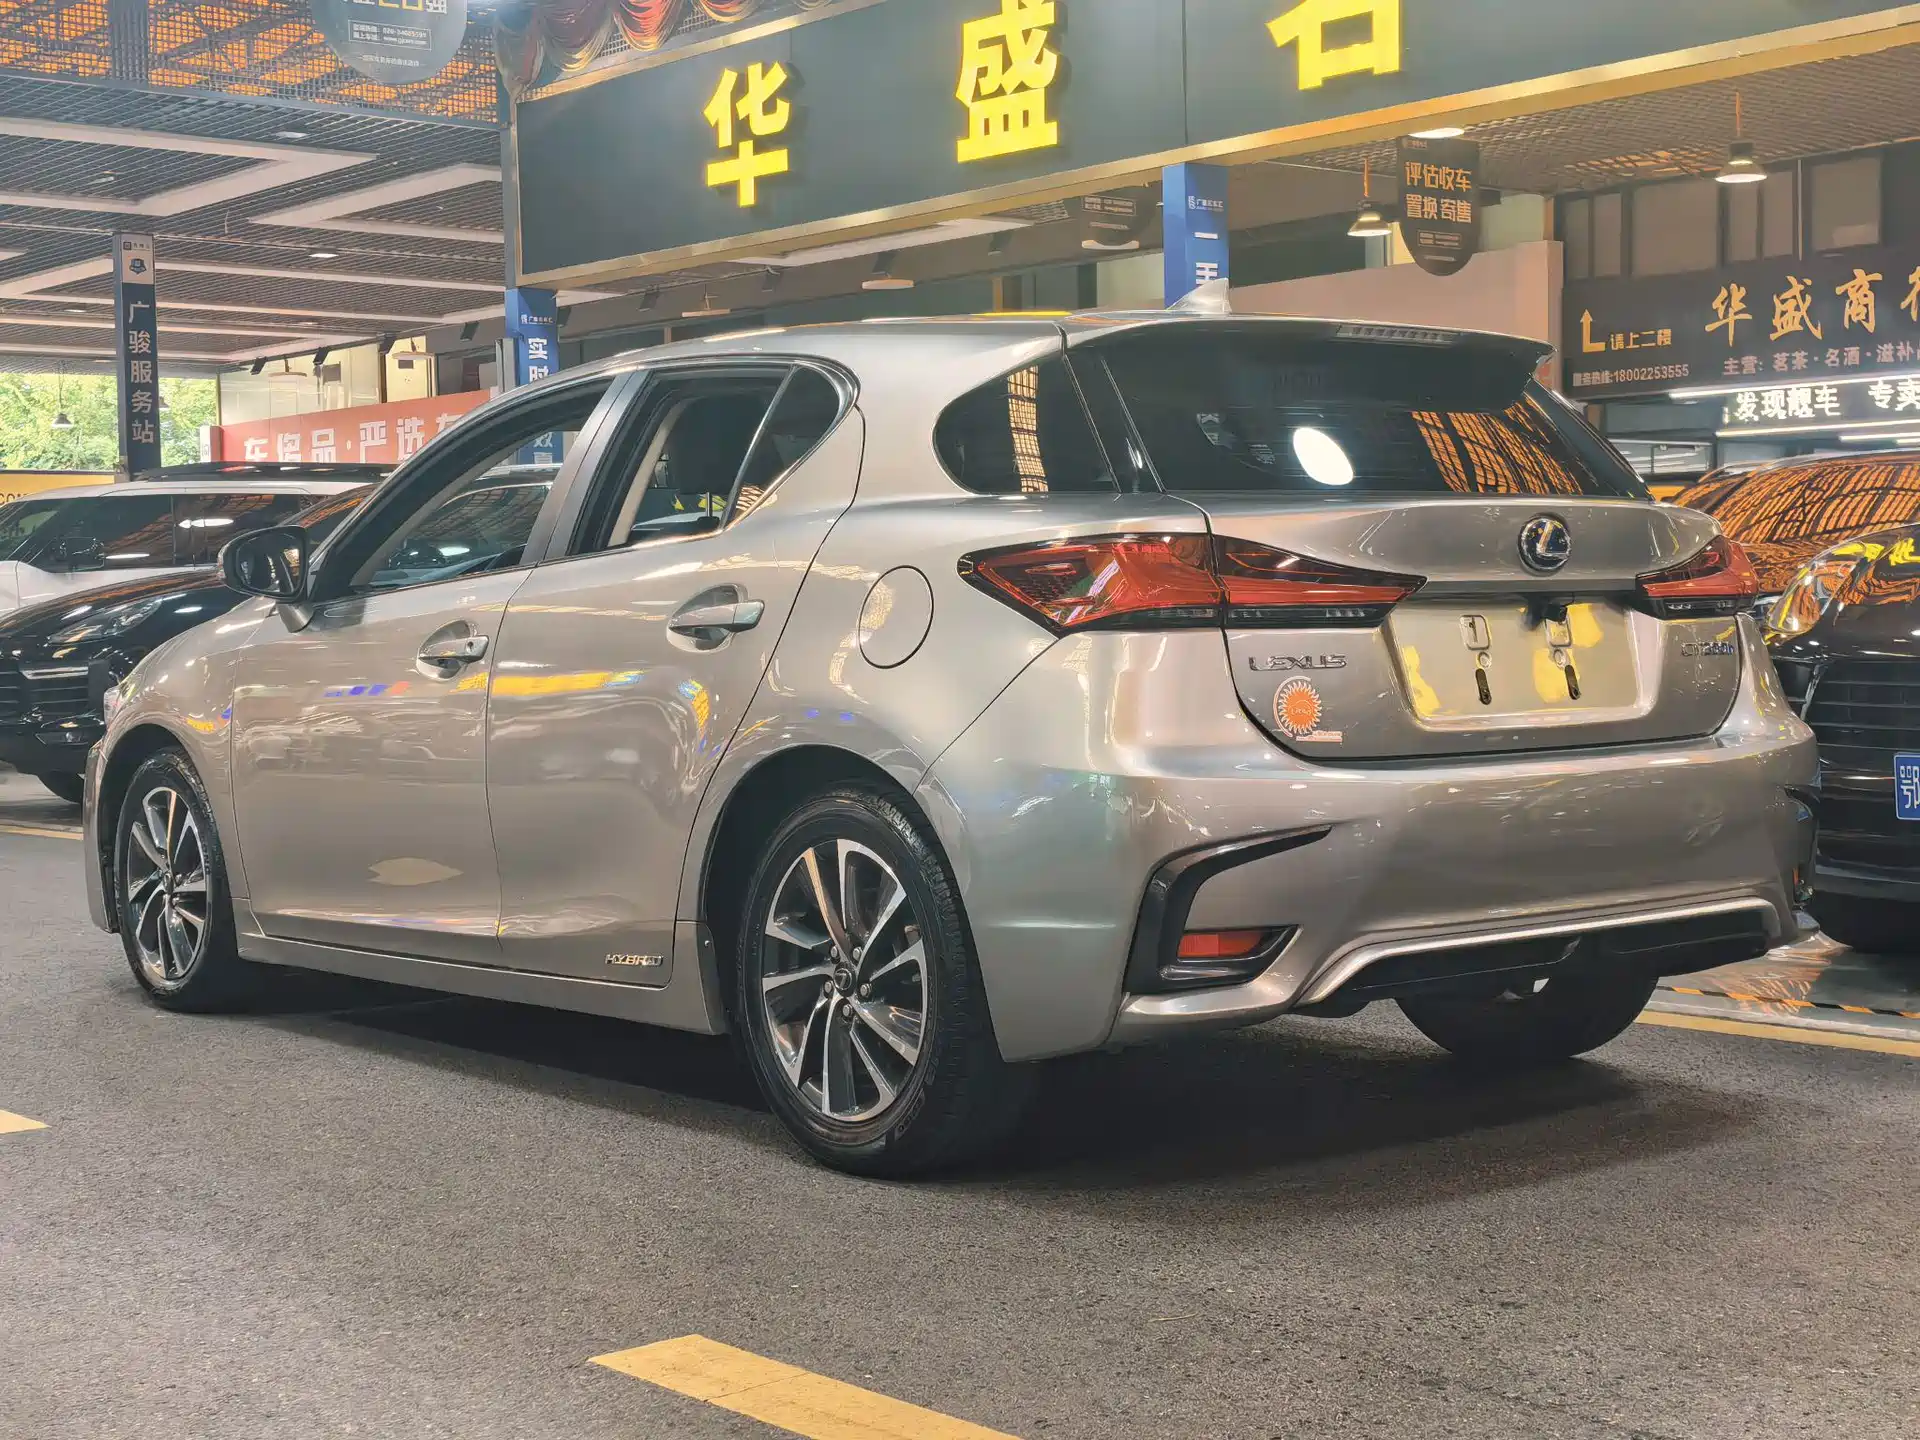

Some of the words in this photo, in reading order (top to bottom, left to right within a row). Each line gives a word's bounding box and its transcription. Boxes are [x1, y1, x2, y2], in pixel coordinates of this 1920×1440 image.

[1405, 161, 1472, 192] 评估收车
[129, 300, 154, 444] 广骏服务站
[1249, 654, 1347, 671] LEXUS
